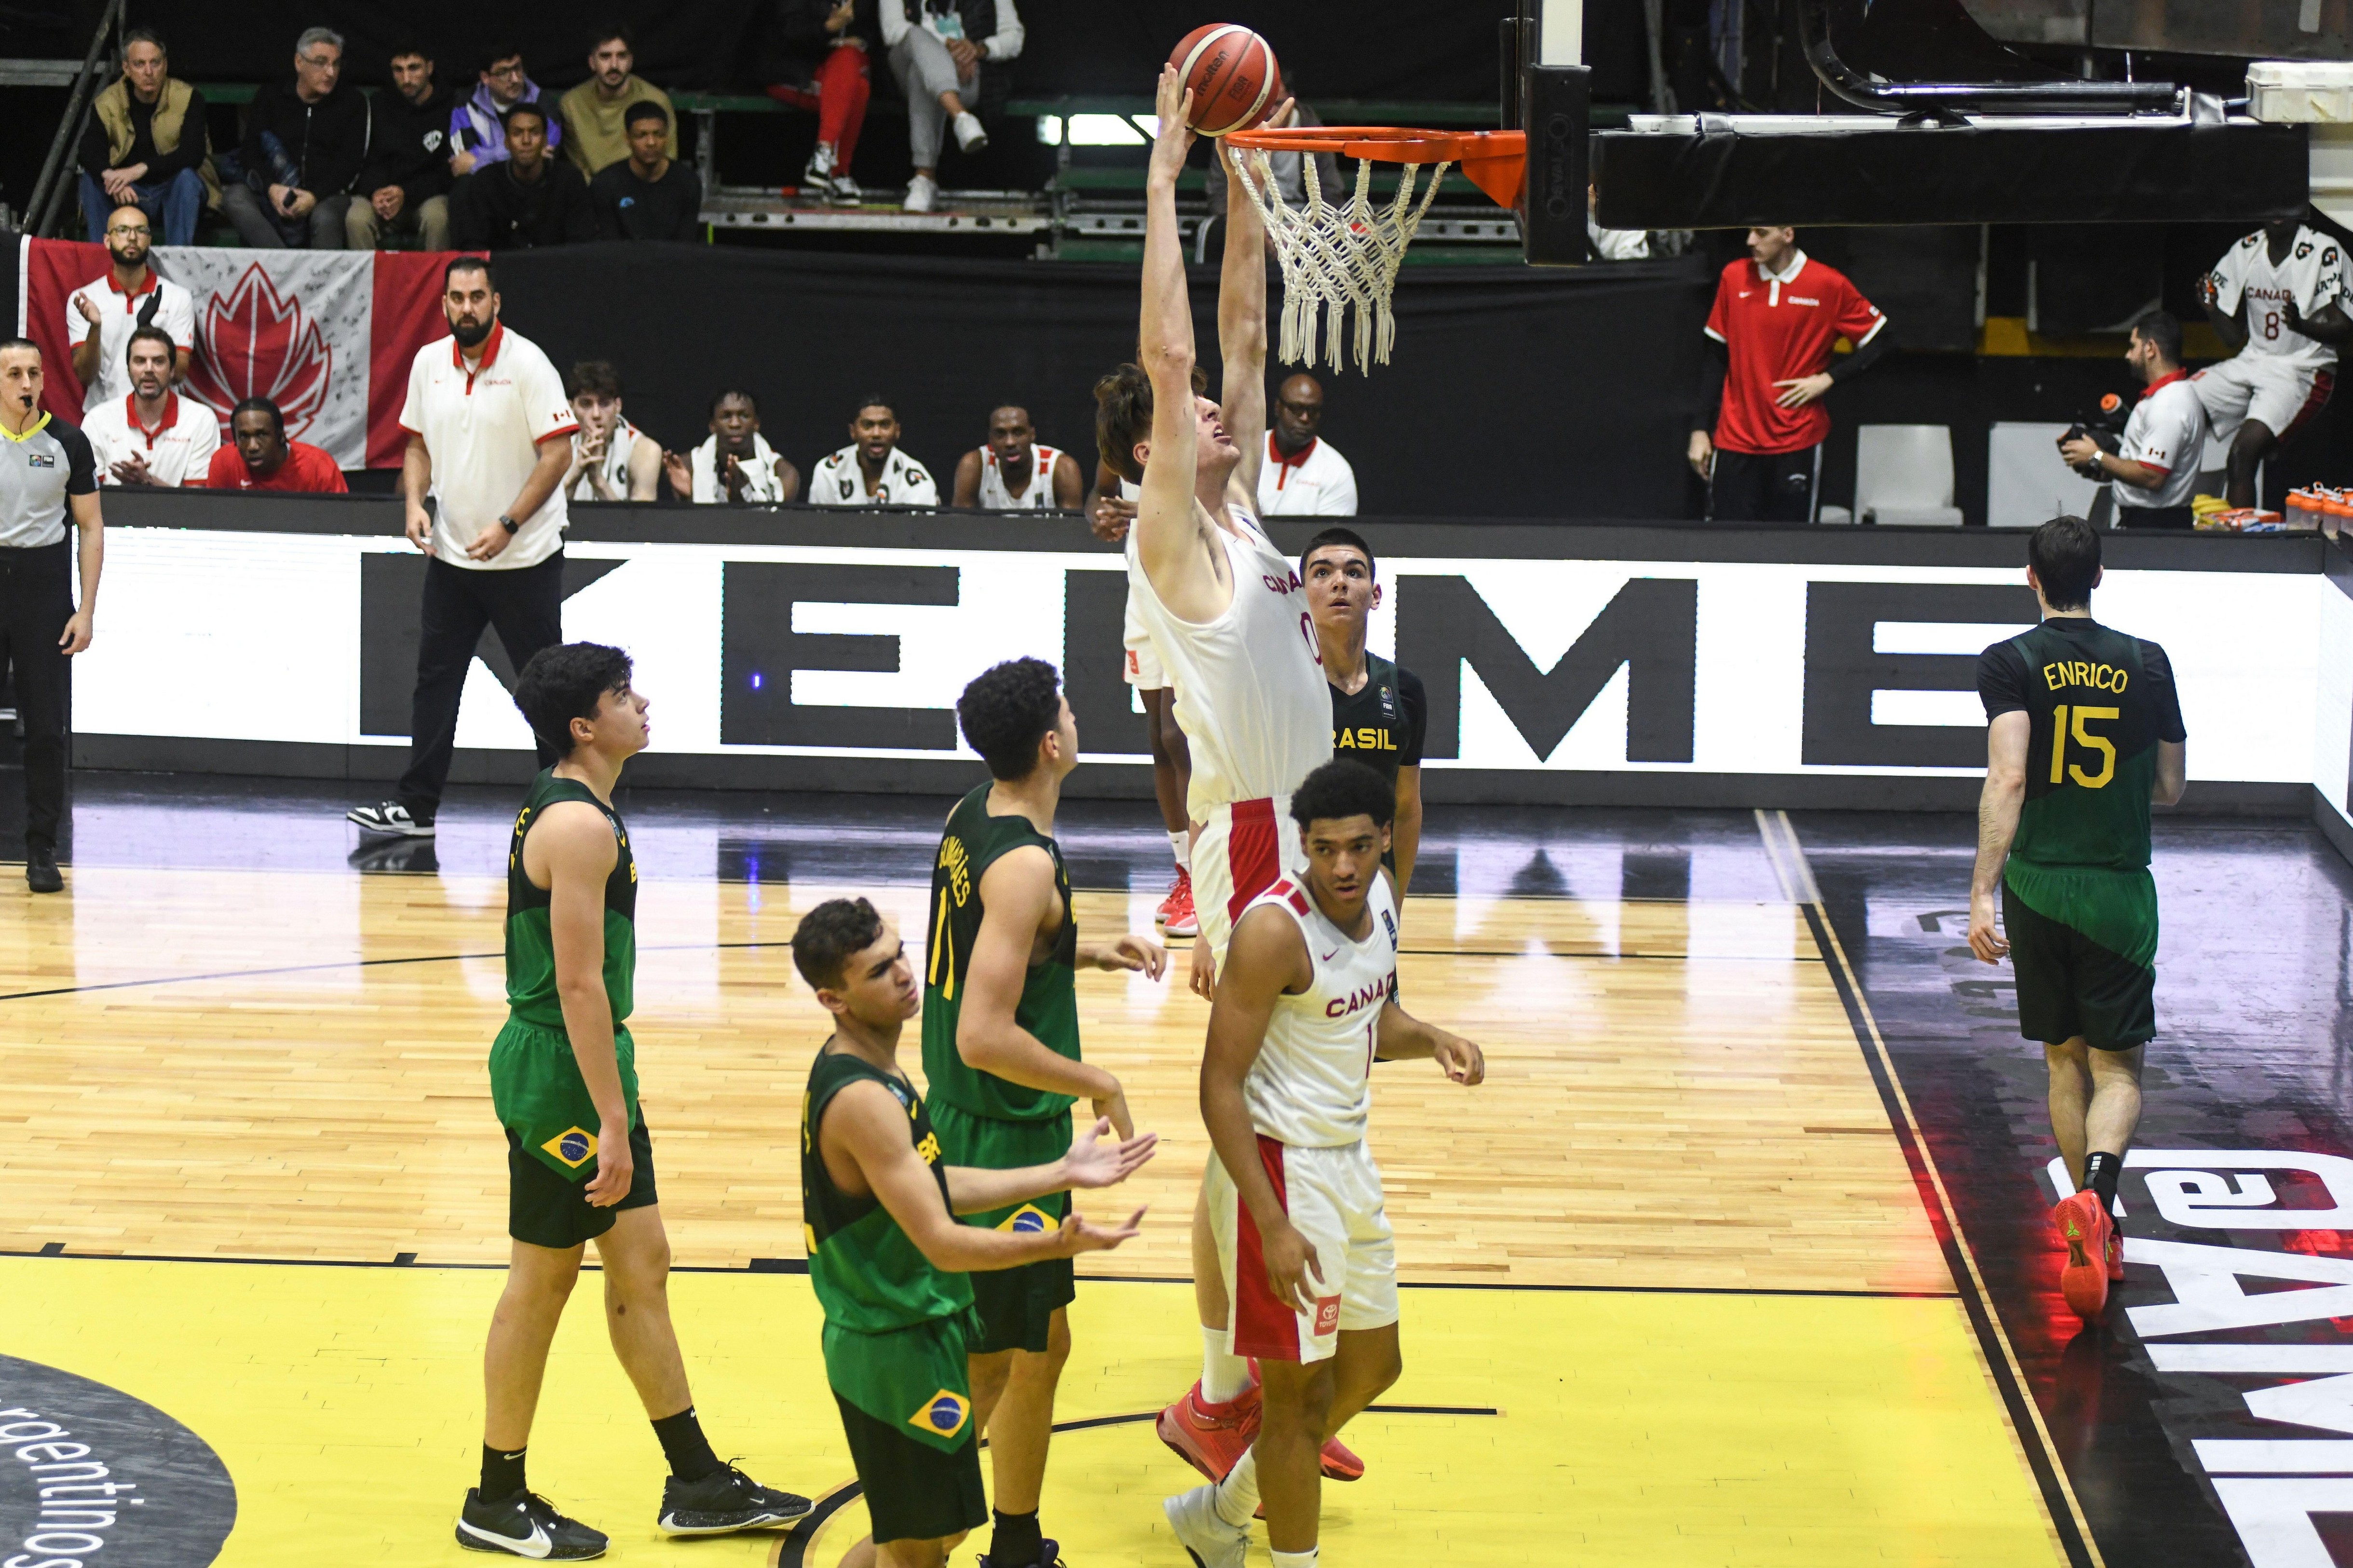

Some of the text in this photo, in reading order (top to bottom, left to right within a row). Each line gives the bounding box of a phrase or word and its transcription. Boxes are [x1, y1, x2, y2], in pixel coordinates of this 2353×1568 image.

[1196, 51, 1229, 96] molten
[2245, 287, 2296, 301] CANAD
[2265, 311, 2279, 340] 8
[1300, 611, 1322, 670] 0
[2044, 661, 2128, 694] ENRICO
[1333, 727, 1397, 751] ASIL
[2050, 704, 2120, 788] 15
[1326, 971, 1395, 1017] CANAD
[0, 1400, 145, 1568] rgentinos
